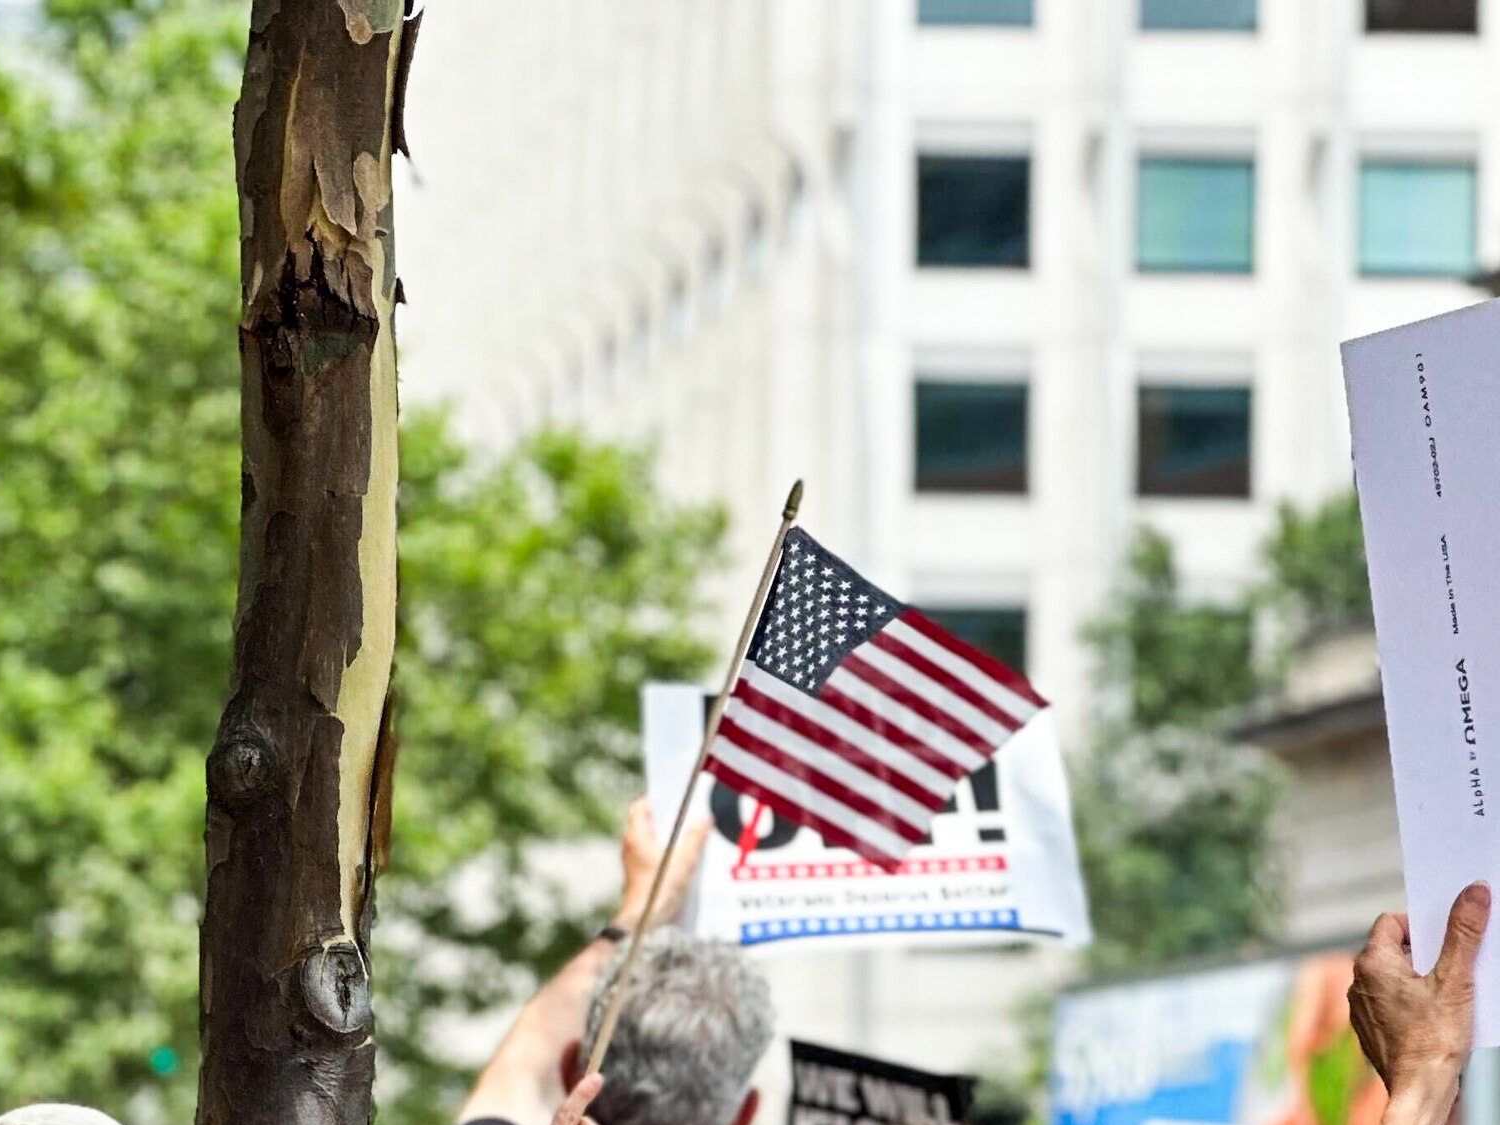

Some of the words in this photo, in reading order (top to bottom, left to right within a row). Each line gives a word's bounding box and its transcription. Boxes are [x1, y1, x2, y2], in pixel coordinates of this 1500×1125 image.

[1440, 534, 1450, 561] USA
[1443, 563, 1454, 586] The
[1448, 602, 1460, 635] Made
